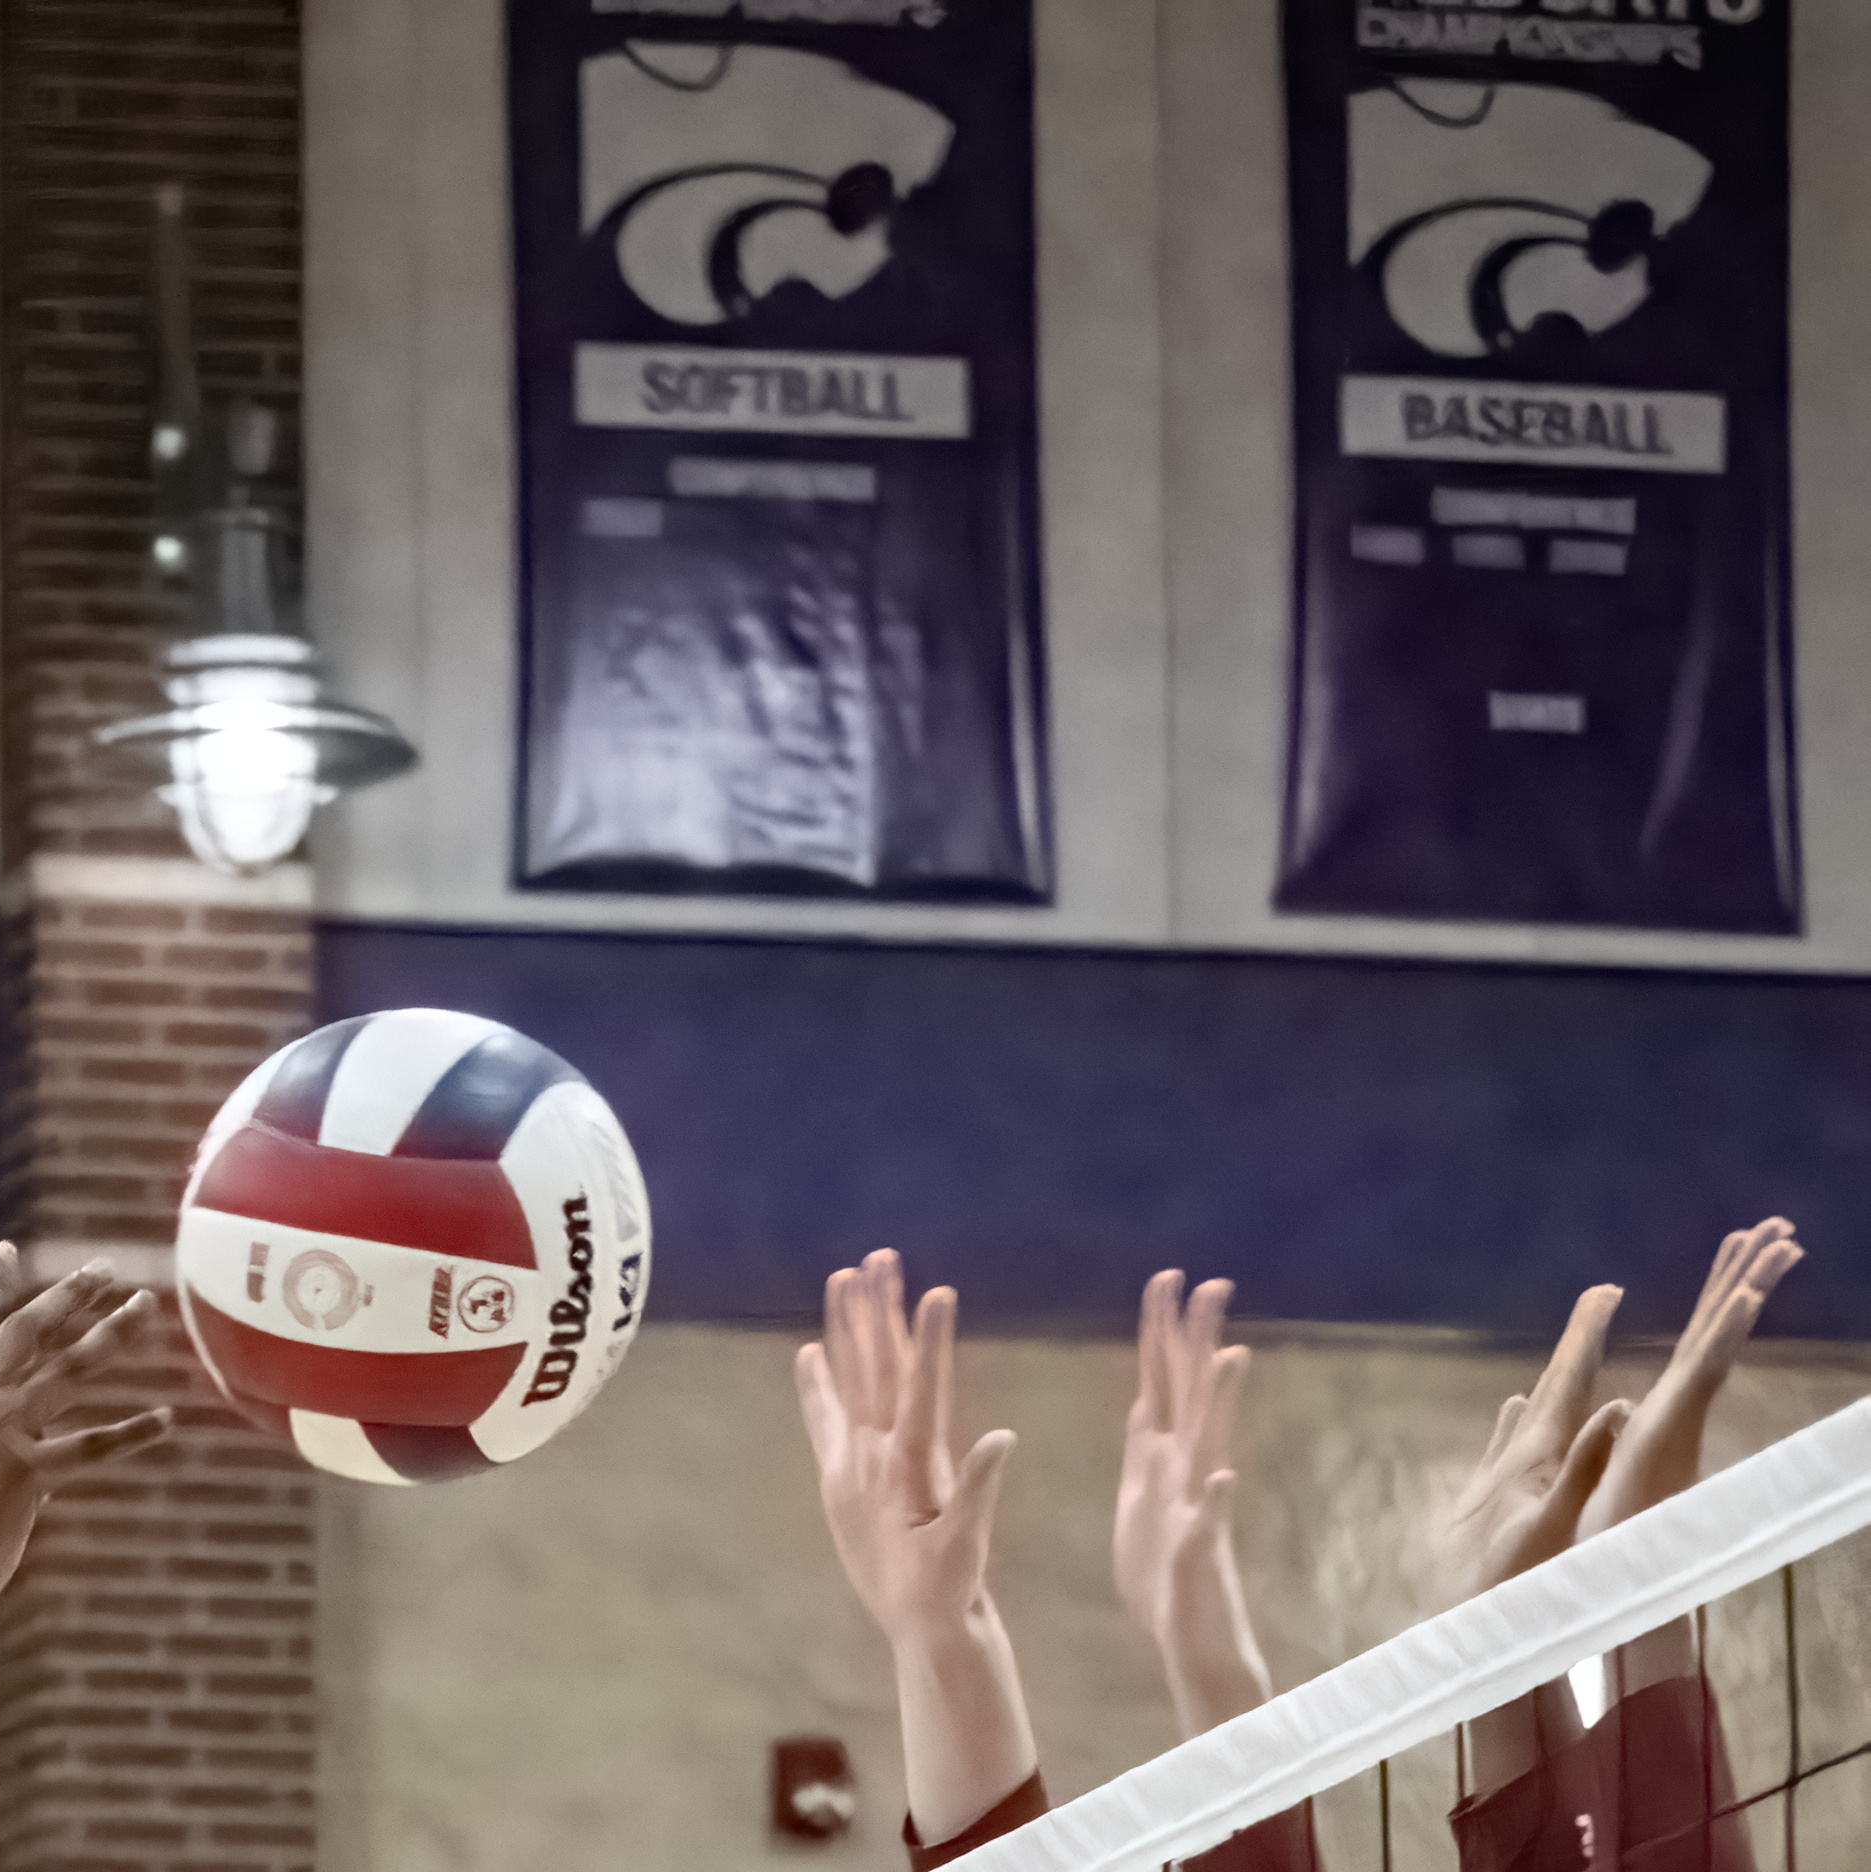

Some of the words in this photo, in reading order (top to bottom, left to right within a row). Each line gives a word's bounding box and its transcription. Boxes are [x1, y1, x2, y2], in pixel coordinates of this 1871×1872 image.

[639, 360, 915, 422] SOFTBALL
[1399, 392, 1674, 458] BASEBALL
[521, 1186, 594, 1408] Wilson
